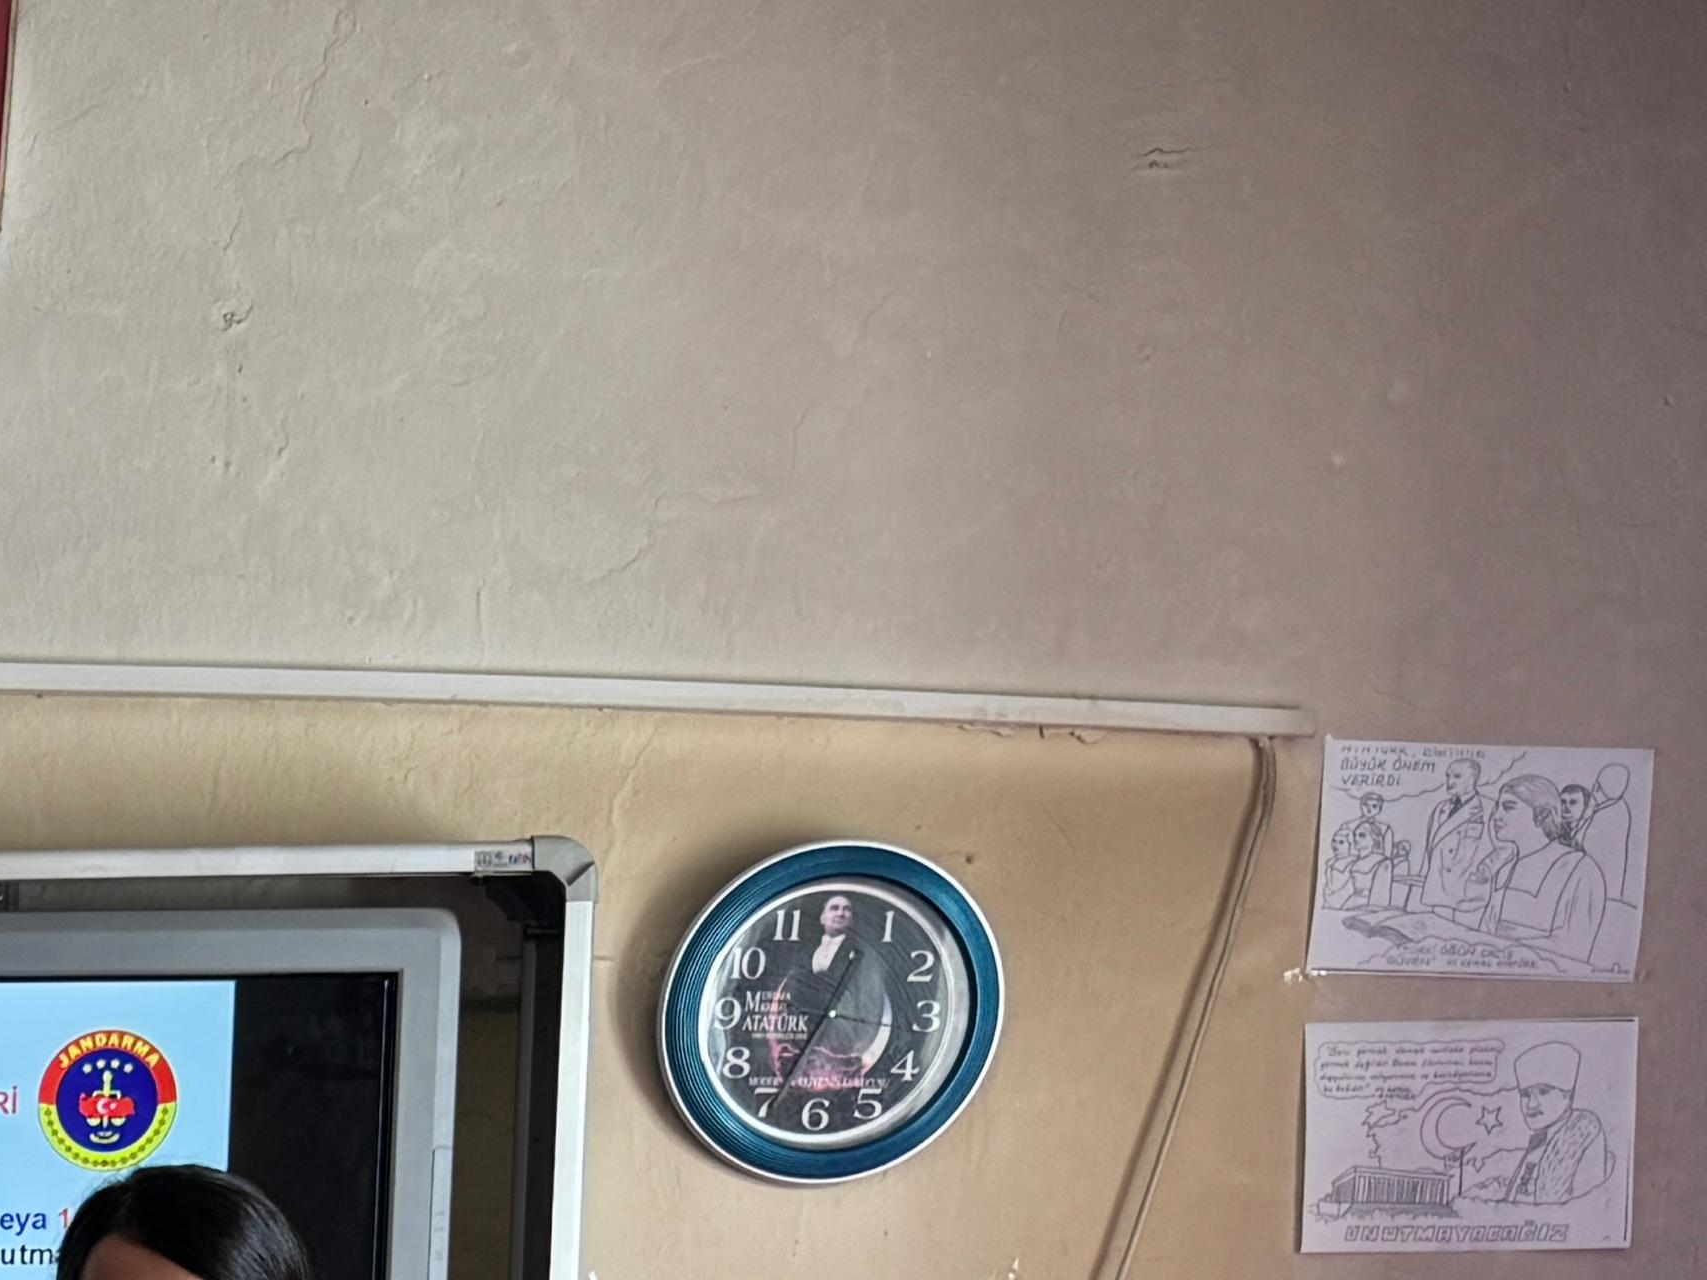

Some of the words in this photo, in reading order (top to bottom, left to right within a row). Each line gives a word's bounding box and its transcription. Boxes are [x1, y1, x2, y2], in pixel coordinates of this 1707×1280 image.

[774, 909, 801, 942] 11
[882, 910, 895, 943] 1
[730, 947, 766, 980] 10
[906, 950, 935, 983] 2
[714, 997, 741, 1030] 9
[742, 1013, 810, 1033] ATATÜRK
[912, 1001, 941, 1033] 3
[58, 1033, 161, 1069] JANDARMA
[722, 1047, 751, 1080] 8
[890, 1050, 920, 1082] 4
[753, 1087, 779, 1119] 7
[801, 1098, 830, 1131] 6
[853, 1087, 885, 1120] 5
